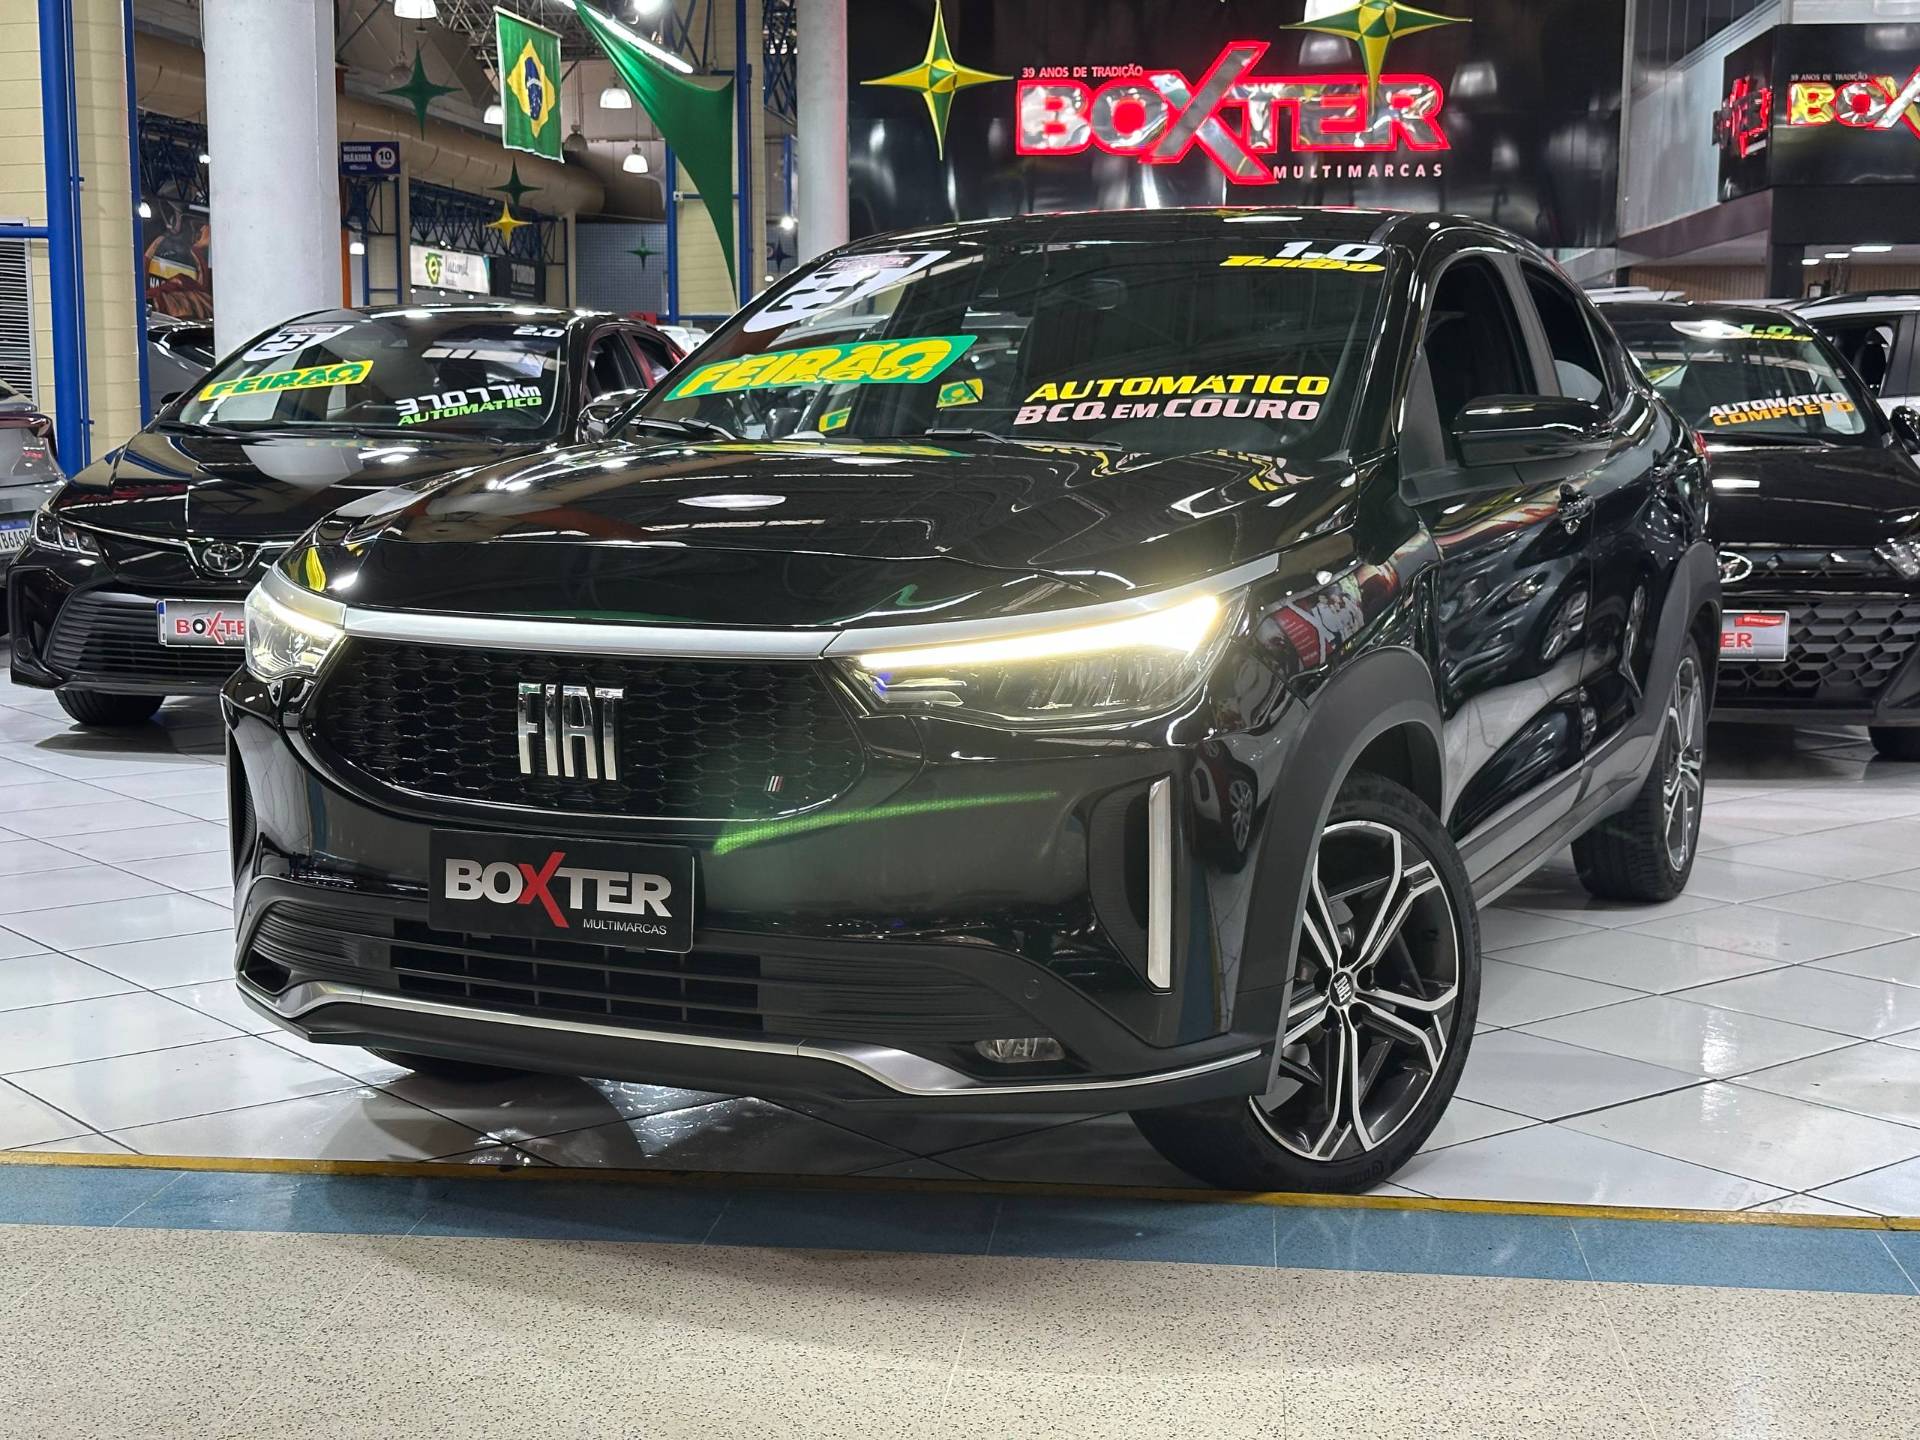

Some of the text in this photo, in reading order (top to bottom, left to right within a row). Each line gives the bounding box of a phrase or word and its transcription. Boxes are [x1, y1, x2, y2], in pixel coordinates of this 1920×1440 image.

[1022, 63, 1144, 78] 39 ANOS DE TRADIÇÃO
[1801, 73, 1820, 81] ANOS
[1822, 73, 1832, 81] DE
[1016, 41, 1452, 185] BOXTER
[378, 151, 392, 161] 10
[1274, 163, 1444, 179] MULTIMARCAS
[1275, 240, 1385, 262] 1.0
[513, 324, 566, 338] 2.0
[1111, 402, 1152, 420] EM
[1162, 398, 1321, 421] COURO
[517, 682, 624, 781] FIAT
[445, 851, 673, 929] BOXTER
[583, 917, 668, 936] MULTIMARCAS
